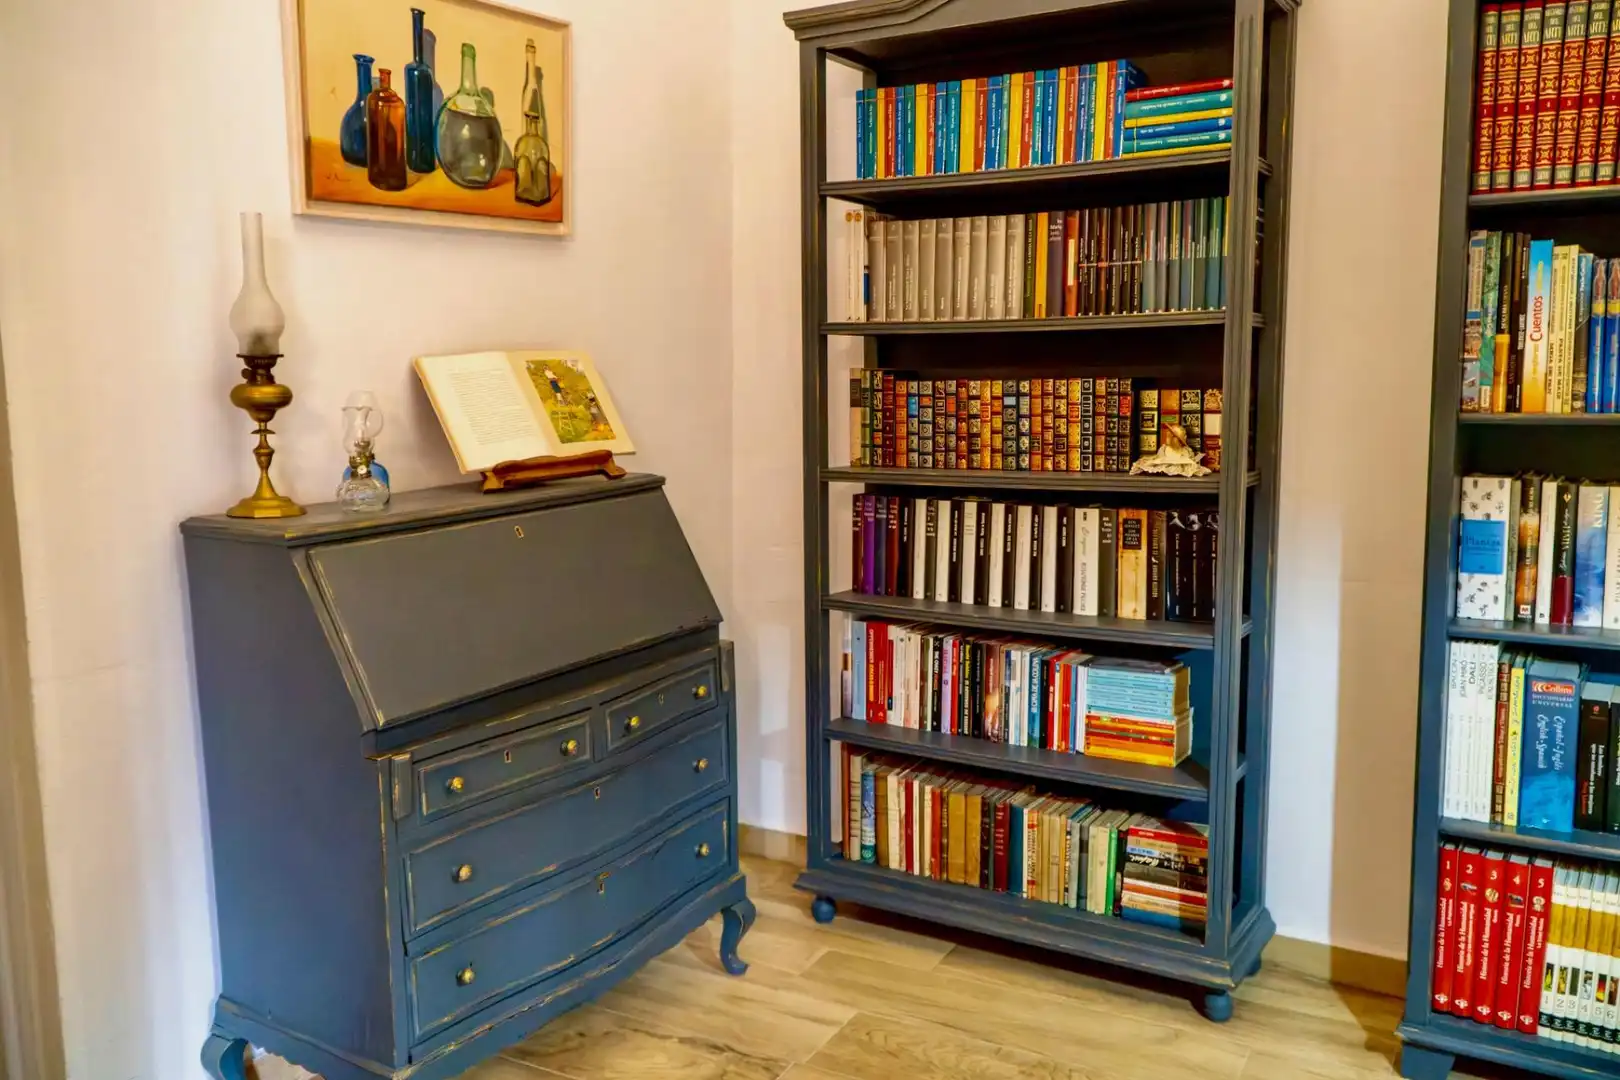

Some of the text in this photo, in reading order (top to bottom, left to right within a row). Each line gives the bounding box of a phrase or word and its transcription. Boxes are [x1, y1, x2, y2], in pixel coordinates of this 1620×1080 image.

[1529, 295, 1543, 342] Cuentos
[1590, 493, 1604, 528] KING
[1544, 684, 1573, 694] Collins
[1446, 860, 1451, 869] 1
[1466, 864, 1474, 874] 2
[1490, 870, 1498, 880] 3
[1512, 875, 1521, 885] 4
[1537, 878, 1545, 888] 5
[1439, 898, 1447, 931] Humanidad
[1459, 901, 1468, 935] Humanidad
[1482, 907, 1492, 942] Humanidad
[1504, 912, 1514, 947] Humanidad
[1527, 916, 1538, 950] Humanidad
[1458, 942, 1465, 950] de
[1457, 950, 1465, 973] Historia
[1480, 957, 1488, 980] Historia
[1501, 962, 1510, 985] Historia
[1523, 966, 1532, 989] Historia
[1544, 996, 1549, 1005] 1
[1556, 999, 1565, 1008] 2
[1568, 999, 1576, 1010] 3
[1580, 1004, 1588, 1013] 4
[1595, 1006, 1602, 1015] 5
[1606, 1010, 1614, 1019] 6
